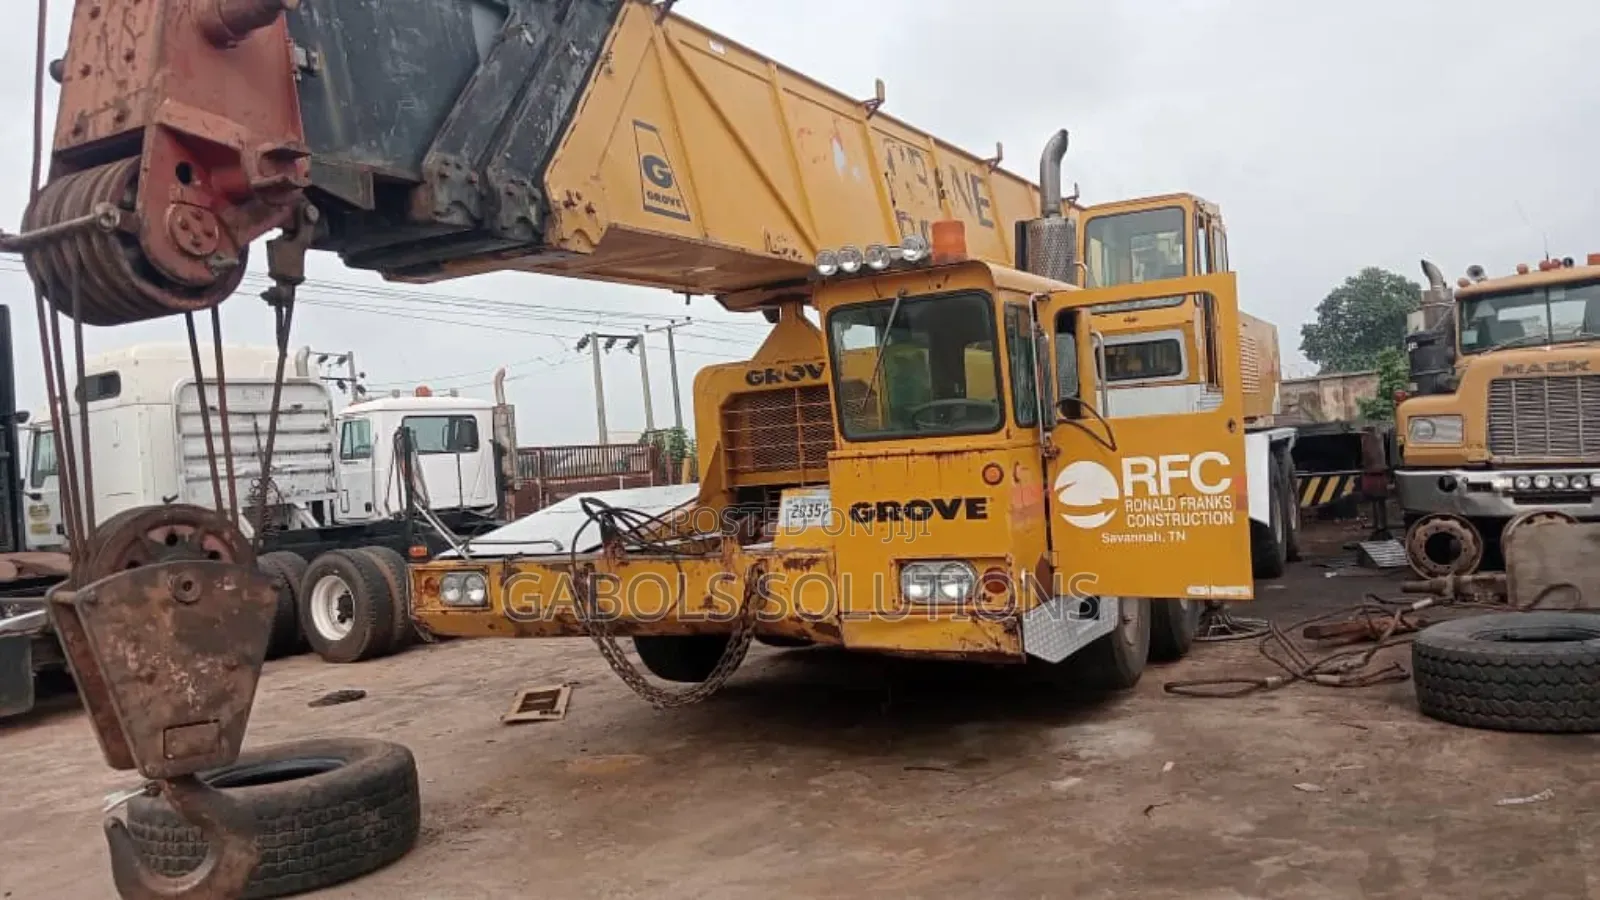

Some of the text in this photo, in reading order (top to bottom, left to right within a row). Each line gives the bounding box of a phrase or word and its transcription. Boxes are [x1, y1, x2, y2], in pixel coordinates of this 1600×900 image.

[642, 154, 674, 189] G
[745, 362, 826, 386] GROV
[1503, 360, 1590, 375] MACK
[1121, 451, 1232, 497] RFC
[849, 497, 989, 524] GROVE
[1125, 495, 1232, 513] RONALD FRANKS
[1127, 510, 1235, 528] CONSTRUCTION
[1101, 530, 1187, 544] Savannah, TN
